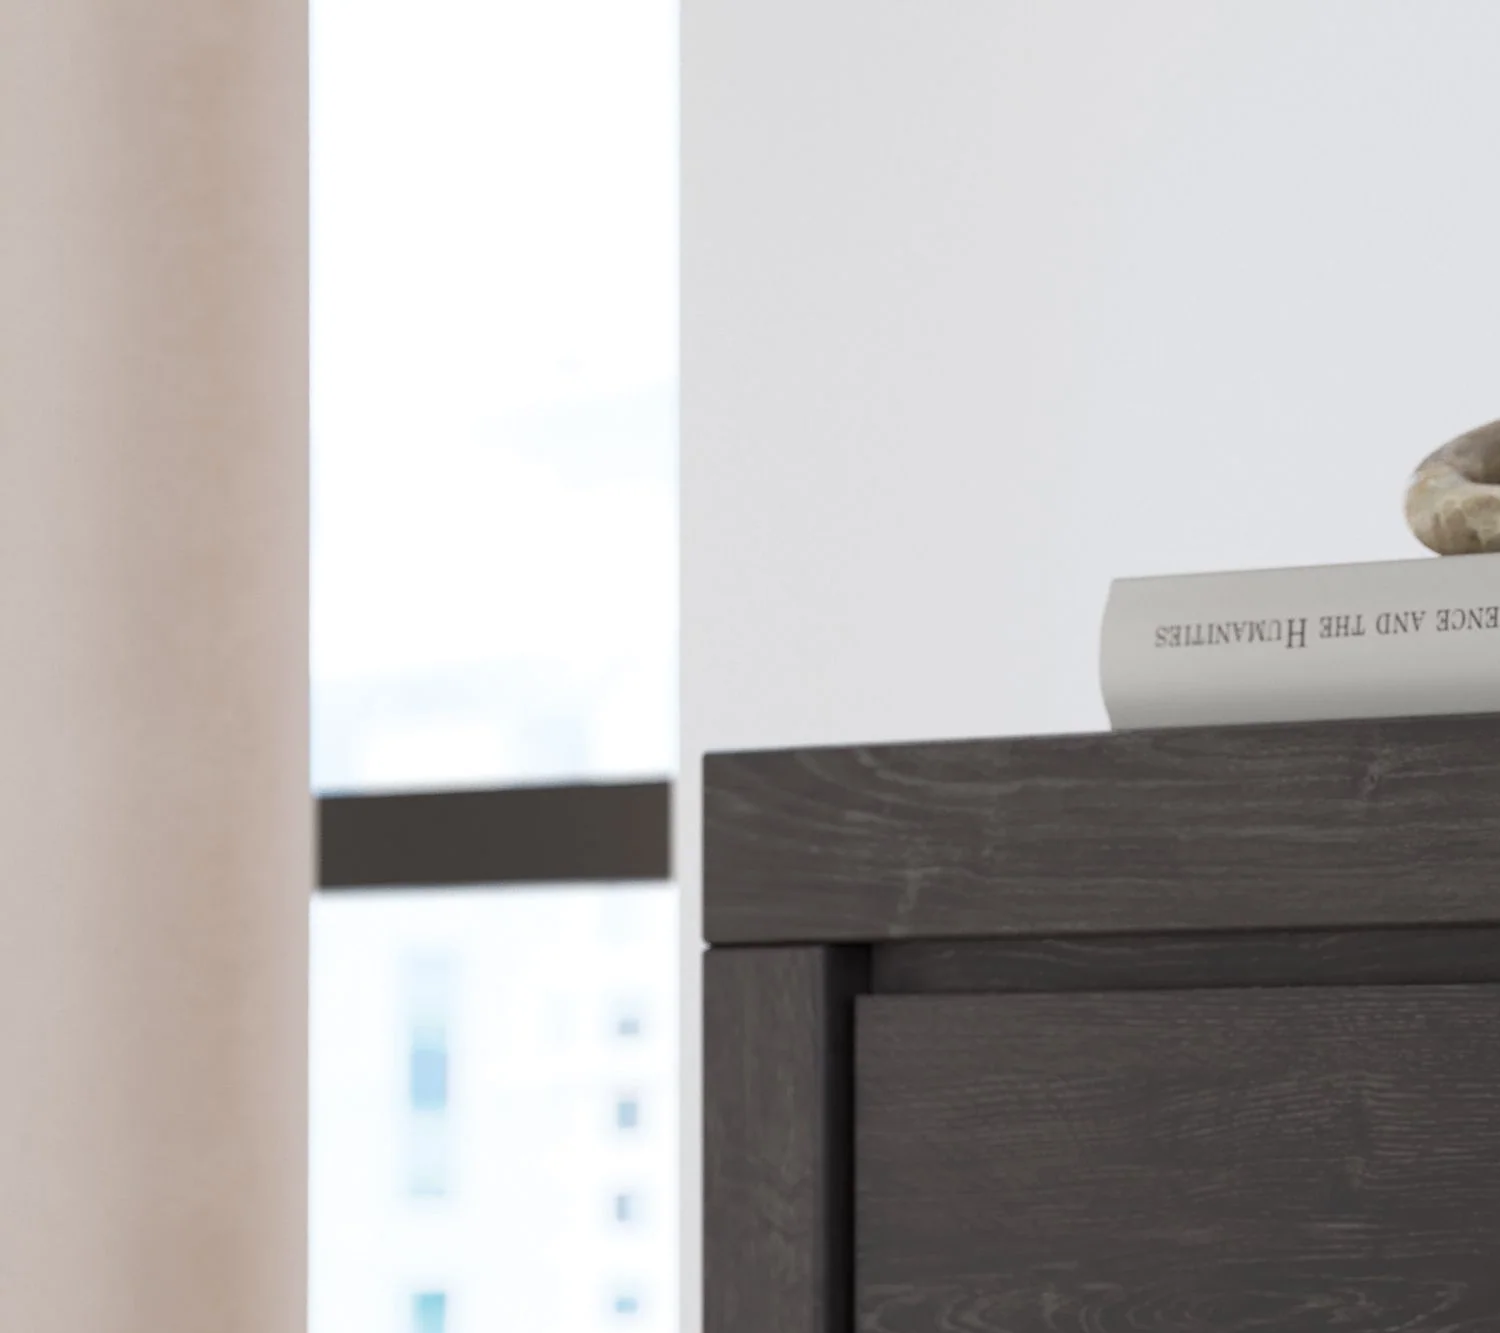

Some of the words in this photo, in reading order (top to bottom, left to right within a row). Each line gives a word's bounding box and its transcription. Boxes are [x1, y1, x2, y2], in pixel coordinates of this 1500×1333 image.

[1154, 617, 1308, 650] HUMANITIES
[1319, 613, 1366, 639] THE
[1375, 610, 1427, 636] AND
